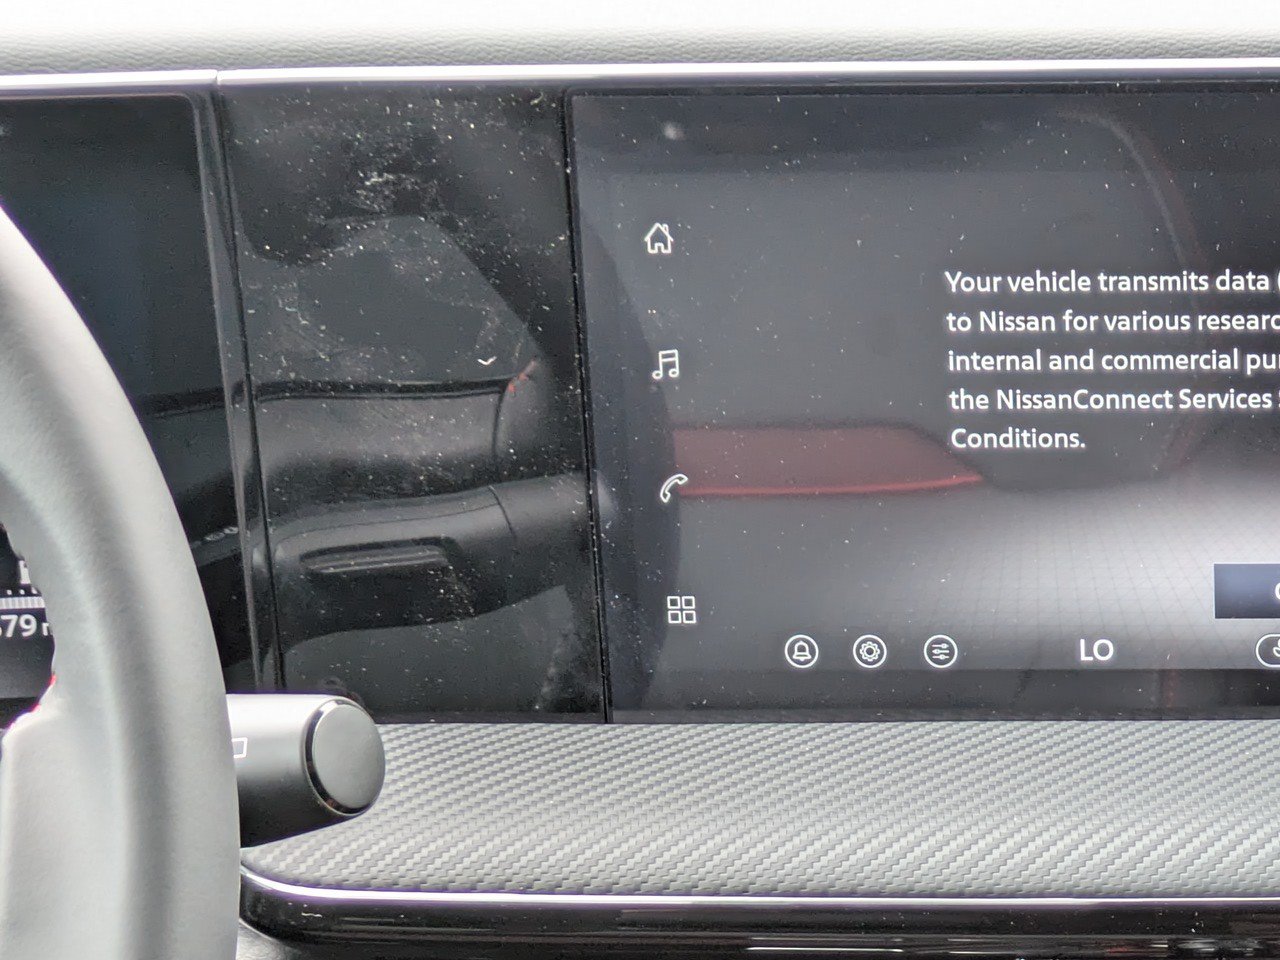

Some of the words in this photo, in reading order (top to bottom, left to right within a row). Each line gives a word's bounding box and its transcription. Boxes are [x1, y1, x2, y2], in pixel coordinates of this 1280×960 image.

[944, 271, 1001, 293] Your
[1006, 269, 1092, 293] vehicle
[1097, 270, 1209, 292] transmits
[1215, 268, 1270, 291] data
[945, 312, 972, 332] to
[979, 310, 1056, 332] Nissan
[1062, 309, 1099, 332] for
[1103, 310, 1191, 332] various
[948, 348, 1042, 372] internal
[1048, 348, 1094, 371] and
[1101, 347, 1239, 371] commercial
[948, 387, 989, 410] the
[996, 388, 1174, 410] NissanConnect
[1178, 388, 1273, 410] Services
[951, 426, 1086, 449] Conditions.
[0, 613, 38, 638] 79
[1079, 638, 1115, 662] LO
